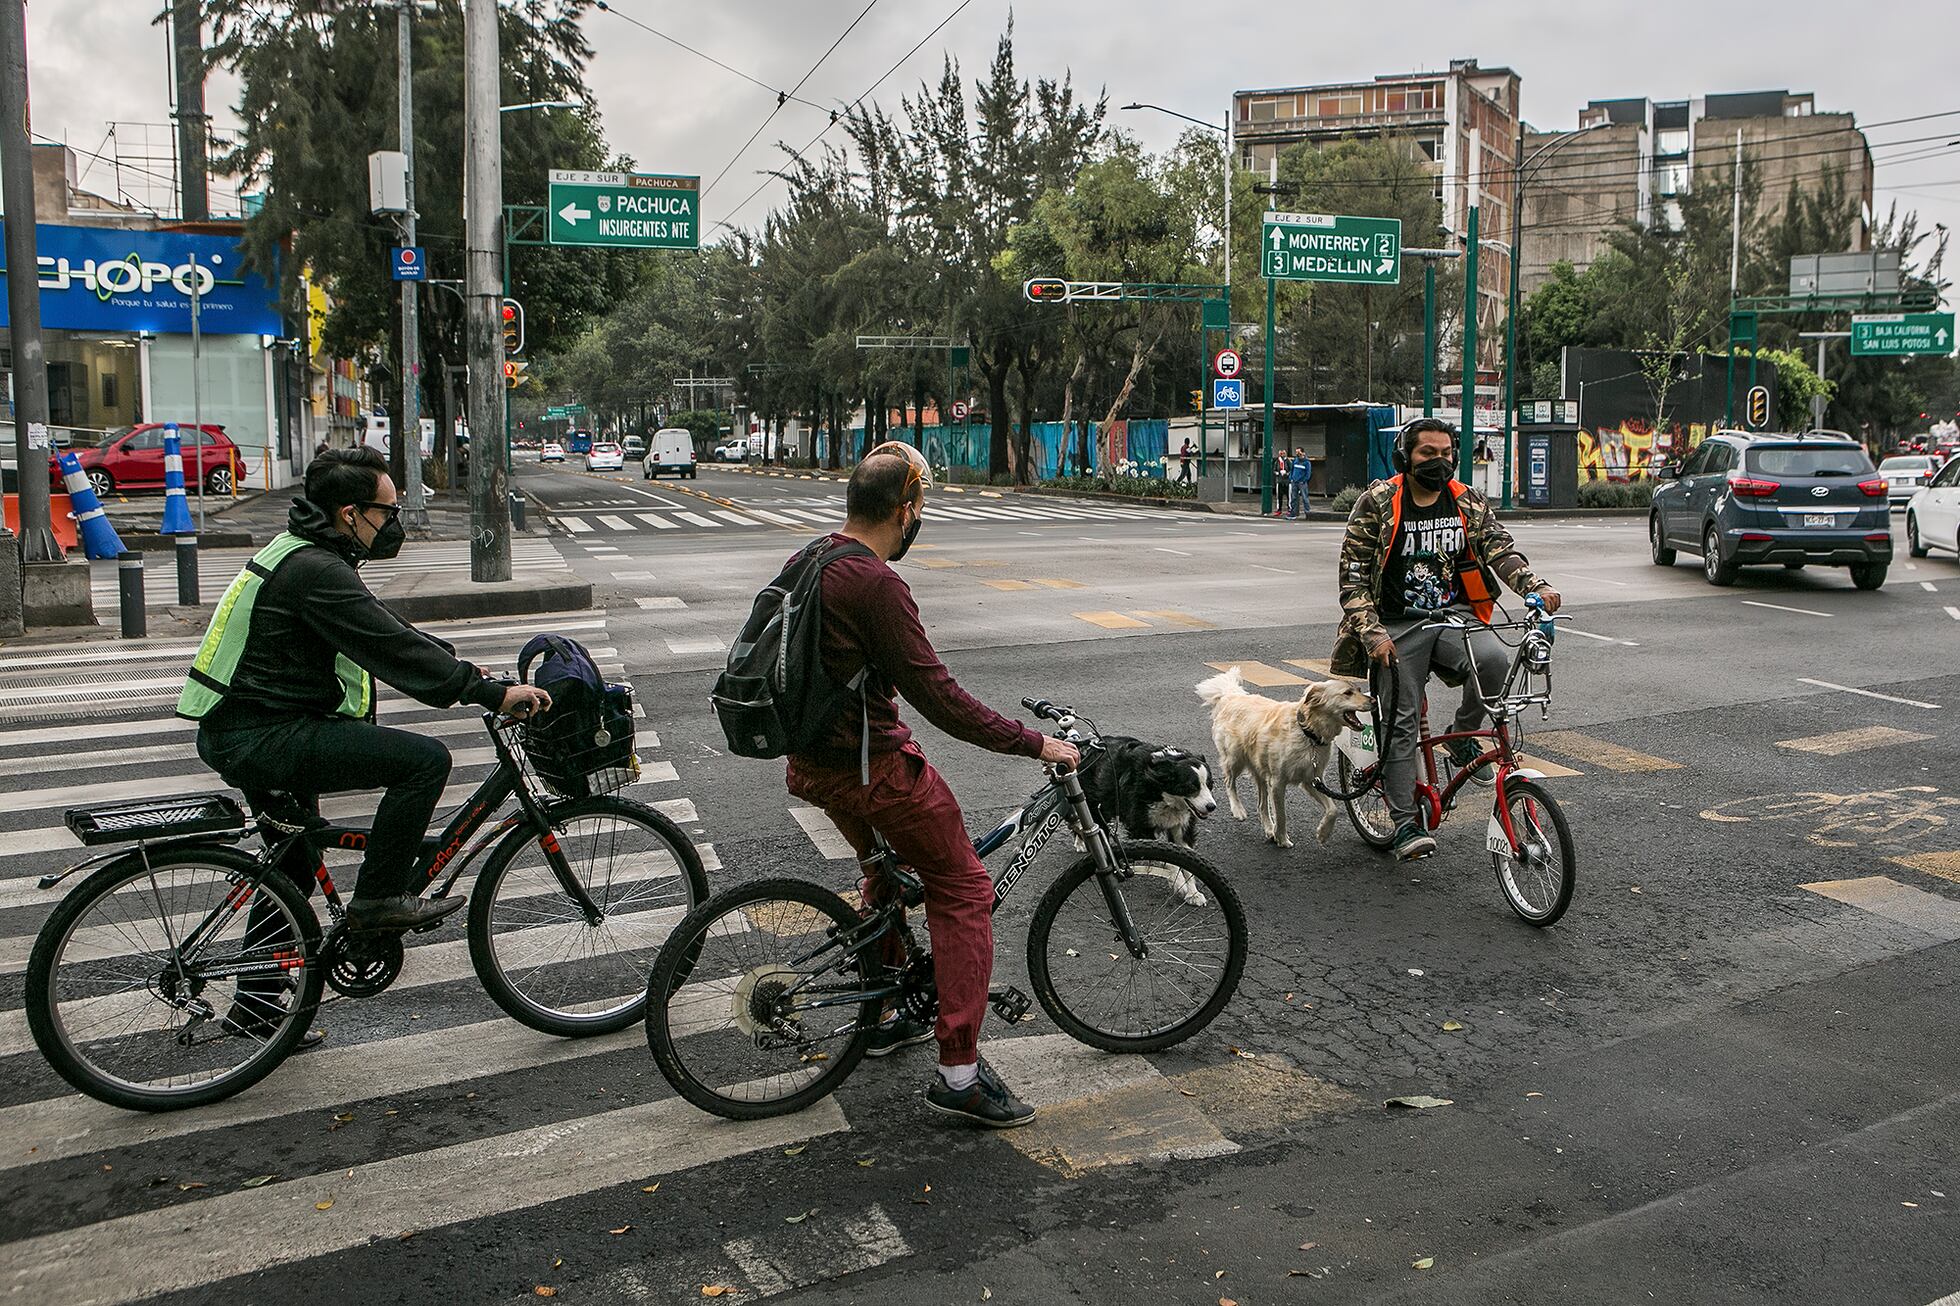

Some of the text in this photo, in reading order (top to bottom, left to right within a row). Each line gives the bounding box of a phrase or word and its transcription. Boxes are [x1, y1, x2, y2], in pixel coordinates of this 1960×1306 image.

[583, 174, 590, 182] 2
[597, 175, 619, 183] SUR
[636, 178, 678, 188] PACHUCA
[617, 195, 691, 215] PACHUCA
[1275, 214, 1290, 222] EJE
[600, 219, 690, 238] INSURGENTES NTE
[1289, 233, 1370, 252] MONTERREY
[1379, 239, 1390, 253] 2
[1273, 256, 1284, 270] 3
[1292, 256, 1372, 274] MEDELLIN
[111, 298, 140, 308] Porque
[156, 300, 177, 308] salud
[202, 303, 234, 311] primero
[1875, 325, 1930, 336] BAJA CALIFORNIA
[1863, 338, 1930, 350] SAN LUIS POTOSI
[1418, 519, 1433, 531] CAN
[1435, 516, 1463, 529] BECOM
[1401, 527, 1465, 556] A HERO
[427, 837, 461, 878] reflex
[995, 811, 1061, 900] BENOTTO
